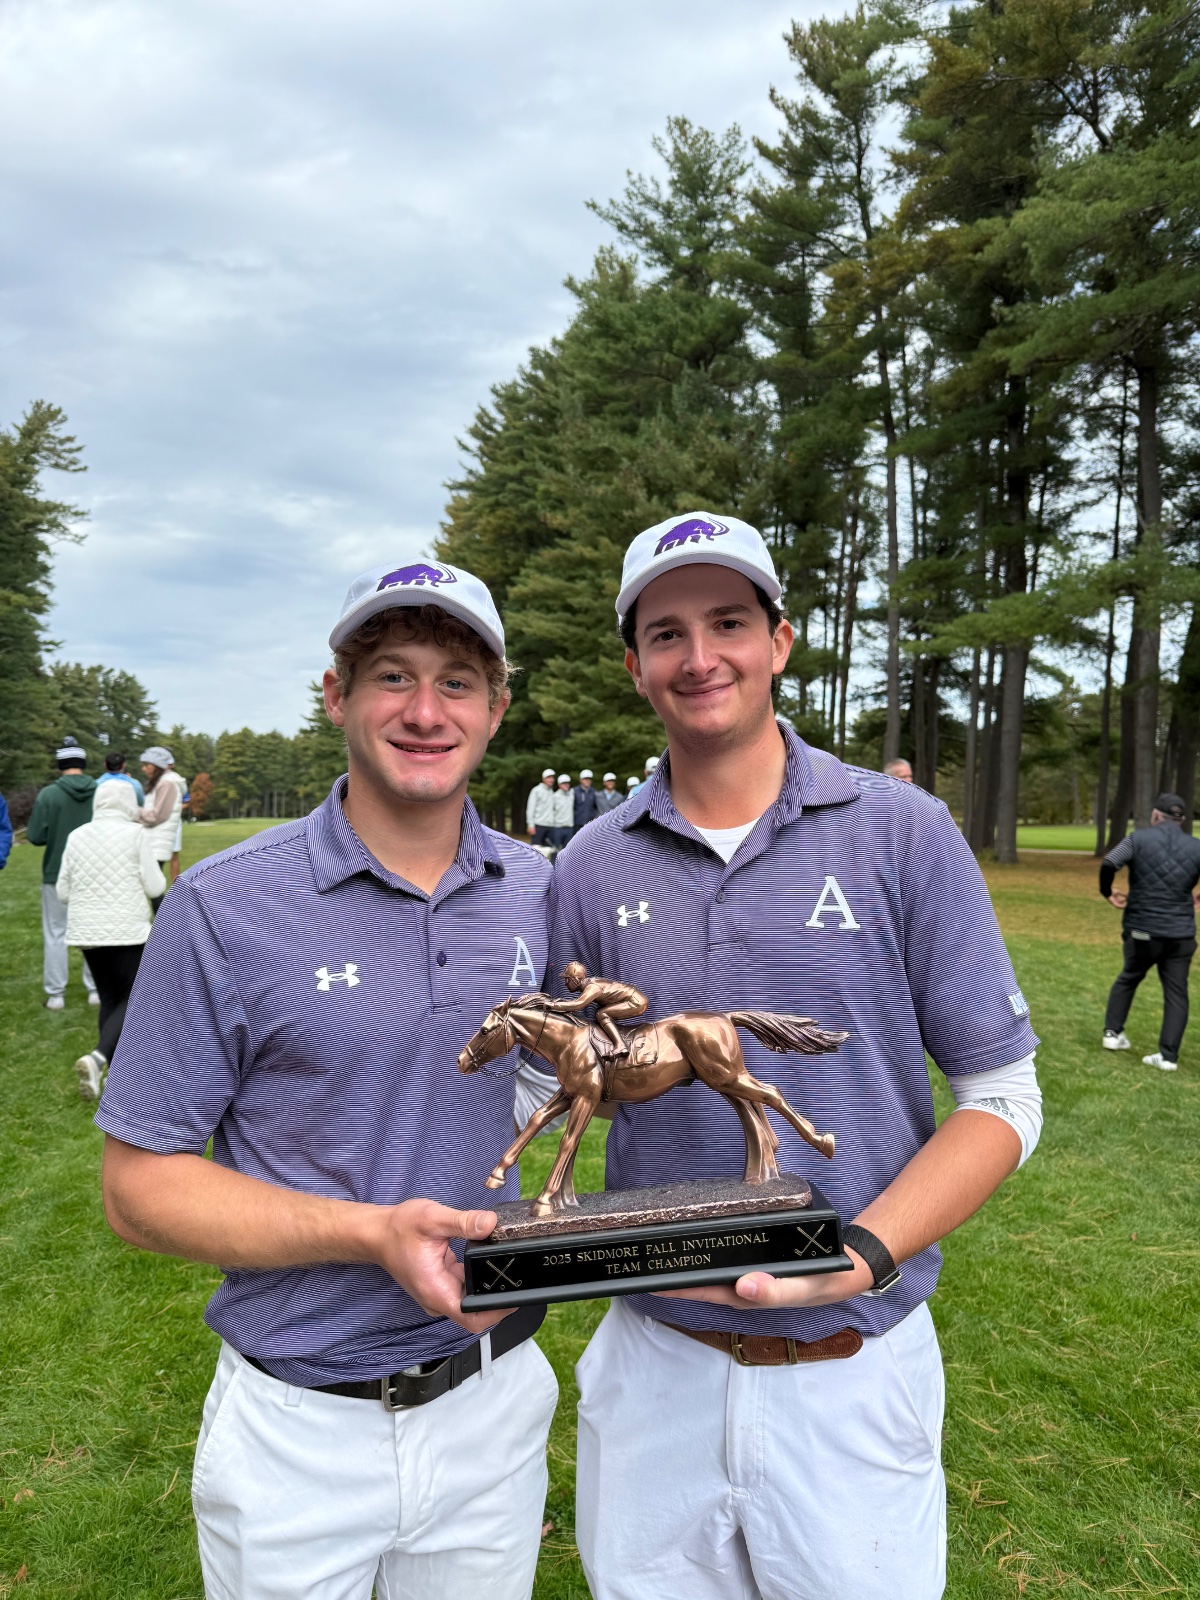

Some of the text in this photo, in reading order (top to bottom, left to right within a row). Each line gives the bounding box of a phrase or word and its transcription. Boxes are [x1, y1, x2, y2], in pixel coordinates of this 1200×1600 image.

[805, 875, 861, 929] A
[508, 936, 537, 985] A
[542, 1232, 770, 1266] 2025 SKIDMORE FALL INVITATIONAL
[605, 1253, 712, 1275] TEAM CHAMPION
